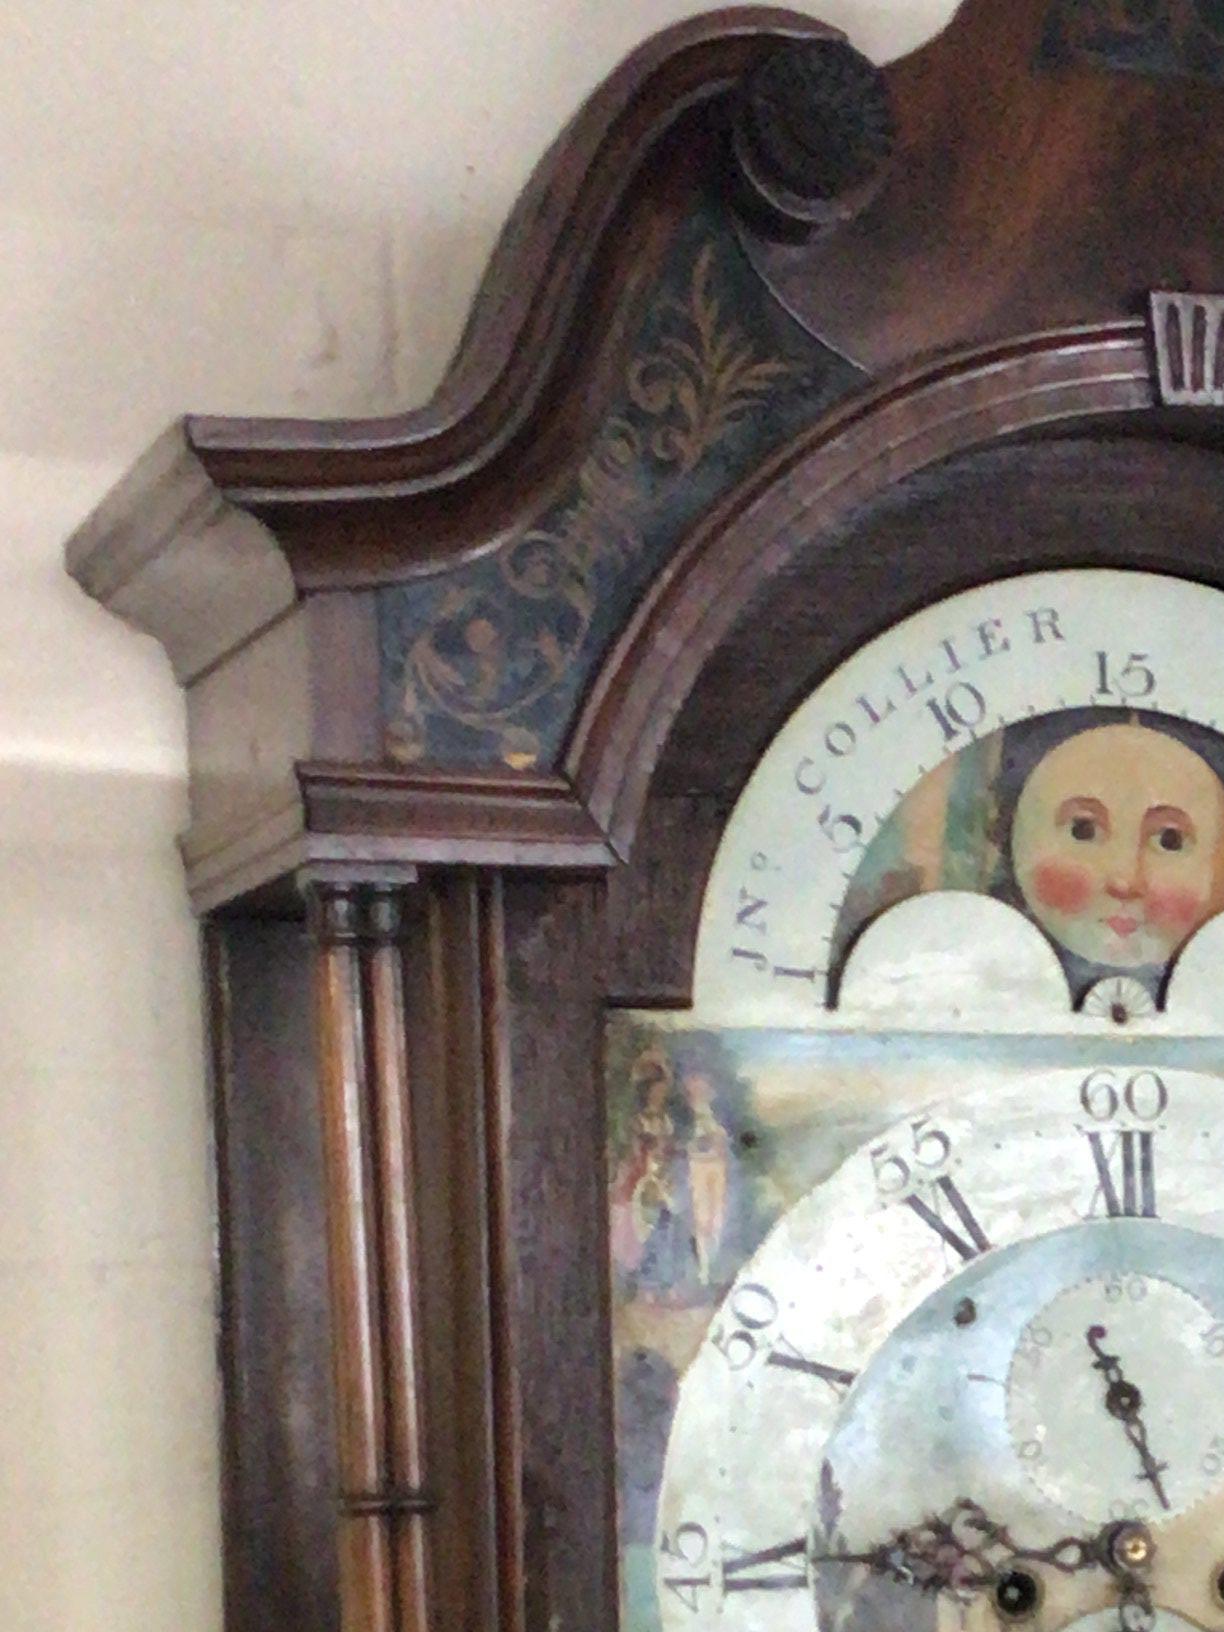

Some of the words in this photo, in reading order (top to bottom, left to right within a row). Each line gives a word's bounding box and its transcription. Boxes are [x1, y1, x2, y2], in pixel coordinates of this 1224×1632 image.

[795, 606, 1065, 797] COLLIER
[1095, 650, 1156, 697] 15
[926, 681, 987, 743] 10
[818, 805, 864, 853] 5
[1079, 1067, 1168, 1123] 60
[870, 1114, 951, 1193] 55
[1078, 1127, 1160, 1220] XII
[907, 1174, 996, 1277] XI
[711, 1281, 779, 1371] 50
[767, 1331, 858, 1400] X
[660, 1520, 713, 1615] 45
[720, 1536, 807, 1596] IX
